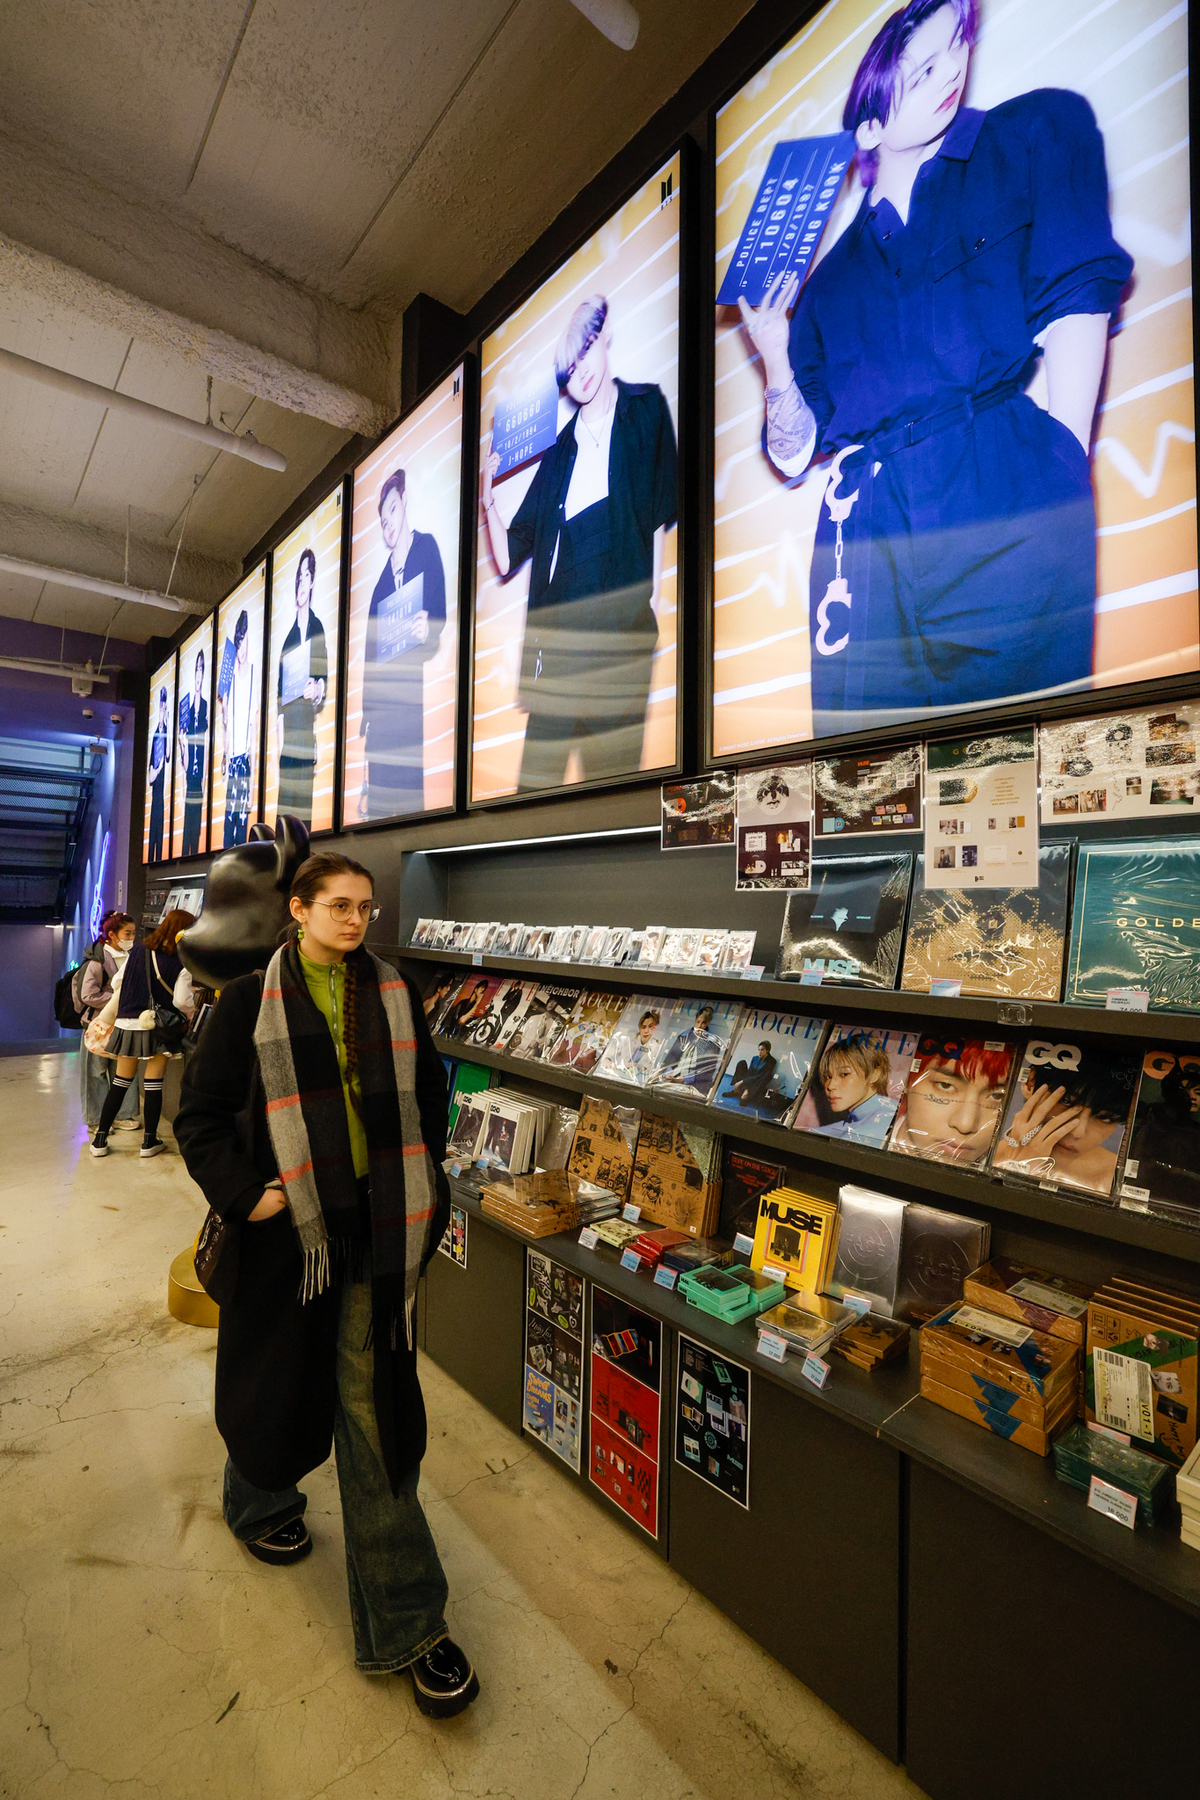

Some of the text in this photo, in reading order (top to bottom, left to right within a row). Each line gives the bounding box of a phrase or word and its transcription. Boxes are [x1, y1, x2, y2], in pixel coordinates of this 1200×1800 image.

[736, 177, 778, 267] POLICE DEPT
[755, 177, 799, 264] 110604
[778, 184, 815, 258] 1/9/1997
[795, 160, 847, 265] JUNG KOOK
[765, 271, 776, 289] DATE
[505, 399, 541, 433] 660660
[504, 424, 538, 451] 18/2/1994
[508, 443, 534, 466] J-HOPE
[541, 985, 580, 999] NEIGHBOR
[753, 1009, 824, 1042] VOGUE
[838, 1024, 918, 1057] VOGUE
[918, 1034, 965, 1061] GQ
[1024, 1039, 1082, 1073] GQ
[760, 1199, 823, 1236] MUSE
